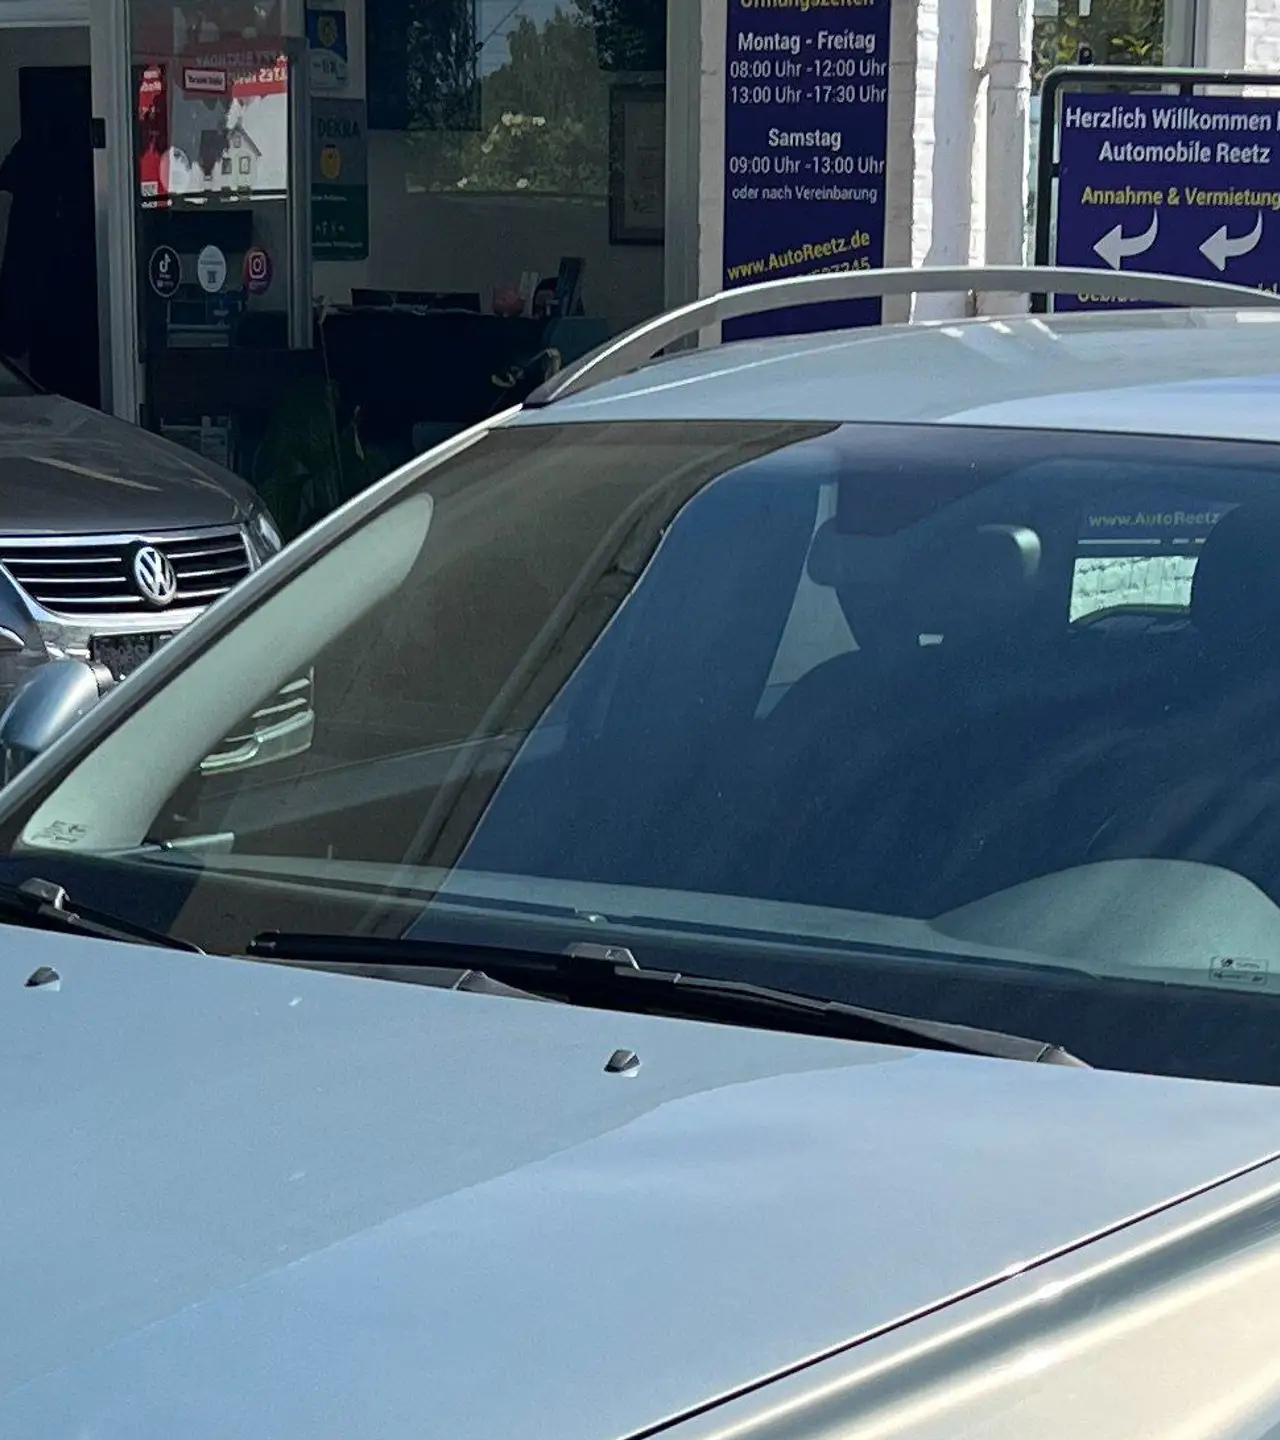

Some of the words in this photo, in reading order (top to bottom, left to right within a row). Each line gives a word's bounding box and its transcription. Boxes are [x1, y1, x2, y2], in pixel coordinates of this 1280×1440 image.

[738, 32, 801, 54] Montag
[817, 29, 876, 53] Freitag
[730, 61, 771, 78] 08:00
[775, 60, 802, 77] Uhr
[859, 59, 887, 77] Uhr
[731, 86, 771, 104] 13:00
[775, 86, 802, 103] Uhr
[859, 85, 887, 103] Uhr
[1066, 106, 1146, 130] Herzlich
[1152, 107, 1271, 131] Willkommen
[768, 128, 842, 152] Samstag
[1099, 140, 1211, 163] Automobile
[1216, 143, 1271, 164] Reetz
[730, 156, 770, 174] 09:00
[774, 156, 801, 173] Uhr
[858, 156, 885, 174] Uhr
[732, 185, 759, 200] oder
[762, 185, 792, 200] nach
[795, 185, 878, 204] Vereinbarung
[1081, 186, 1163, 206] Annahme
[1167, 187, 1180, 206] &
[727, 230, 871, 282] www.AutoReetz.de
